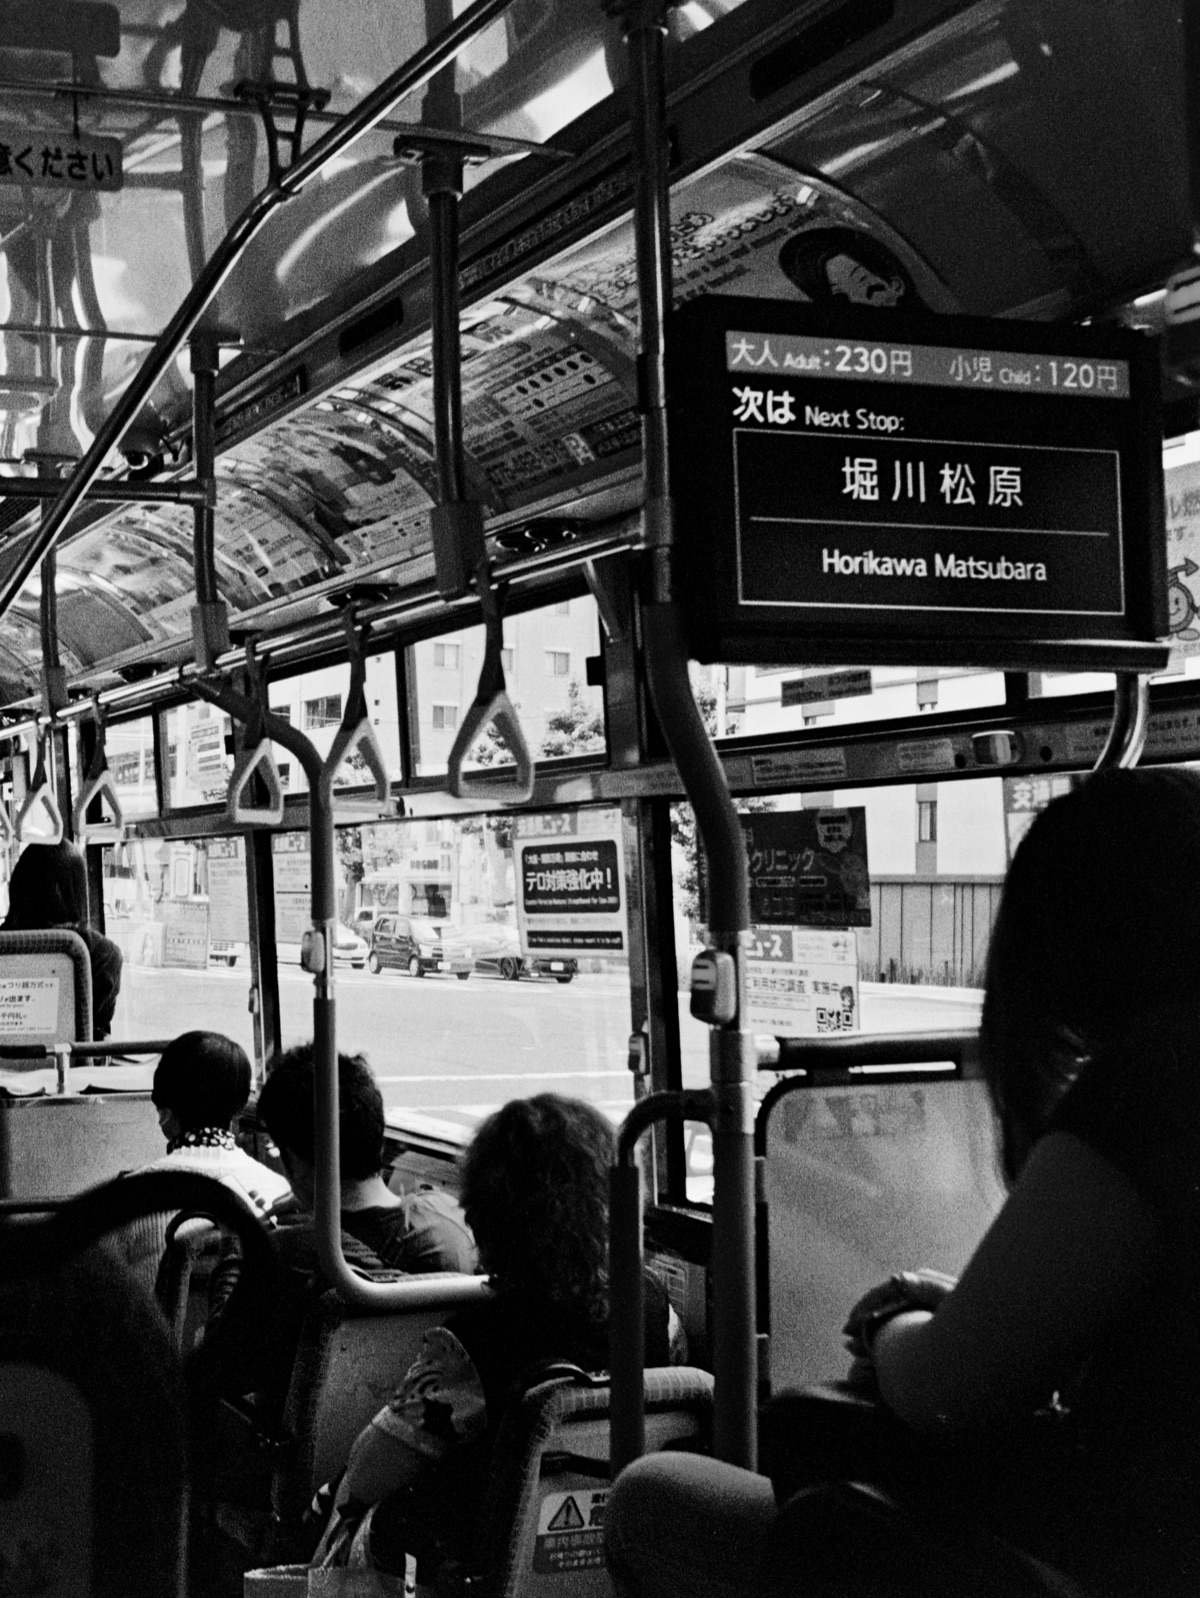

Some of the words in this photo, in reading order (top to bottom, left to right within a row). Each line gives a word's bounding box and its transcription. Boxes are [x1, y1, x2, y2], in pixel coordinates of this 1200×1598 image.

[731, 338, 779, 368] 大人
[834, 345, 912, 377] 230円
[949, 354, 993, 383] 小児
[1049, 361, 1117, 391] 120円
[732, 386, 797, 424] 次は
[805, 406, 849, 428] Next
[856, 409, 905, 432] Stop:
[841, 456, 1024, 507] 堀川松原
[822, 548, 927, 578] Horikawa
[935, 553, 1047, 582] Matsubara
